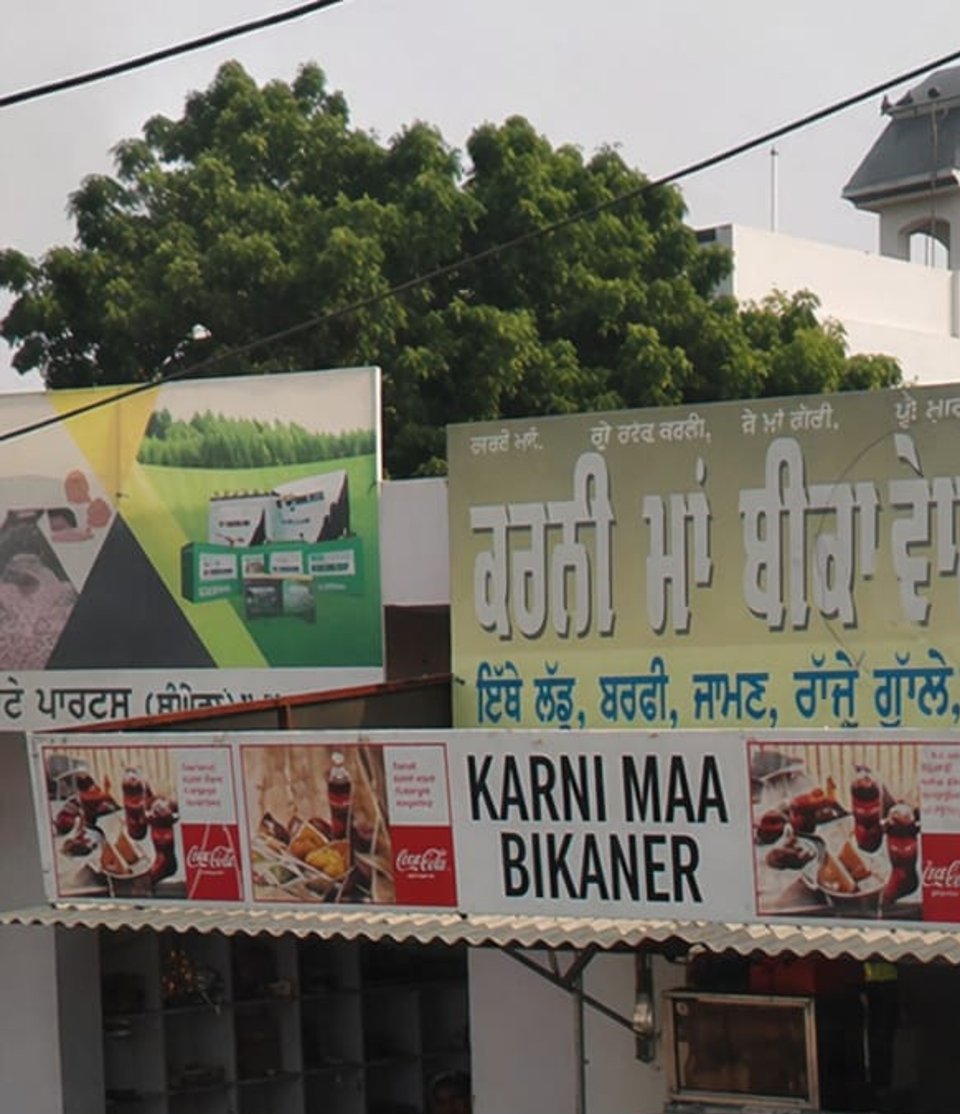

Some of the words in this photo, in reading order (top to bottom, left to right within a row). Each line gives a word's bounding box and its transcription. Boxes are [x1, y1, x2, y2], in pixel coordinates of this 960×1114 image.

[469, 451, 617, 641] ਕਰਨੀ
[642, 456, 713, 637] ਮਾਂ
[36, 688, 133, 720] ਪਾਰਟਸ
[692, 671, 778, 728] ਜਾਮਣ,
[466, 754, 607, 822] KARNI
[621, 754, 730, 824] MAA
[500, 831, 703, 904] BIKANER
